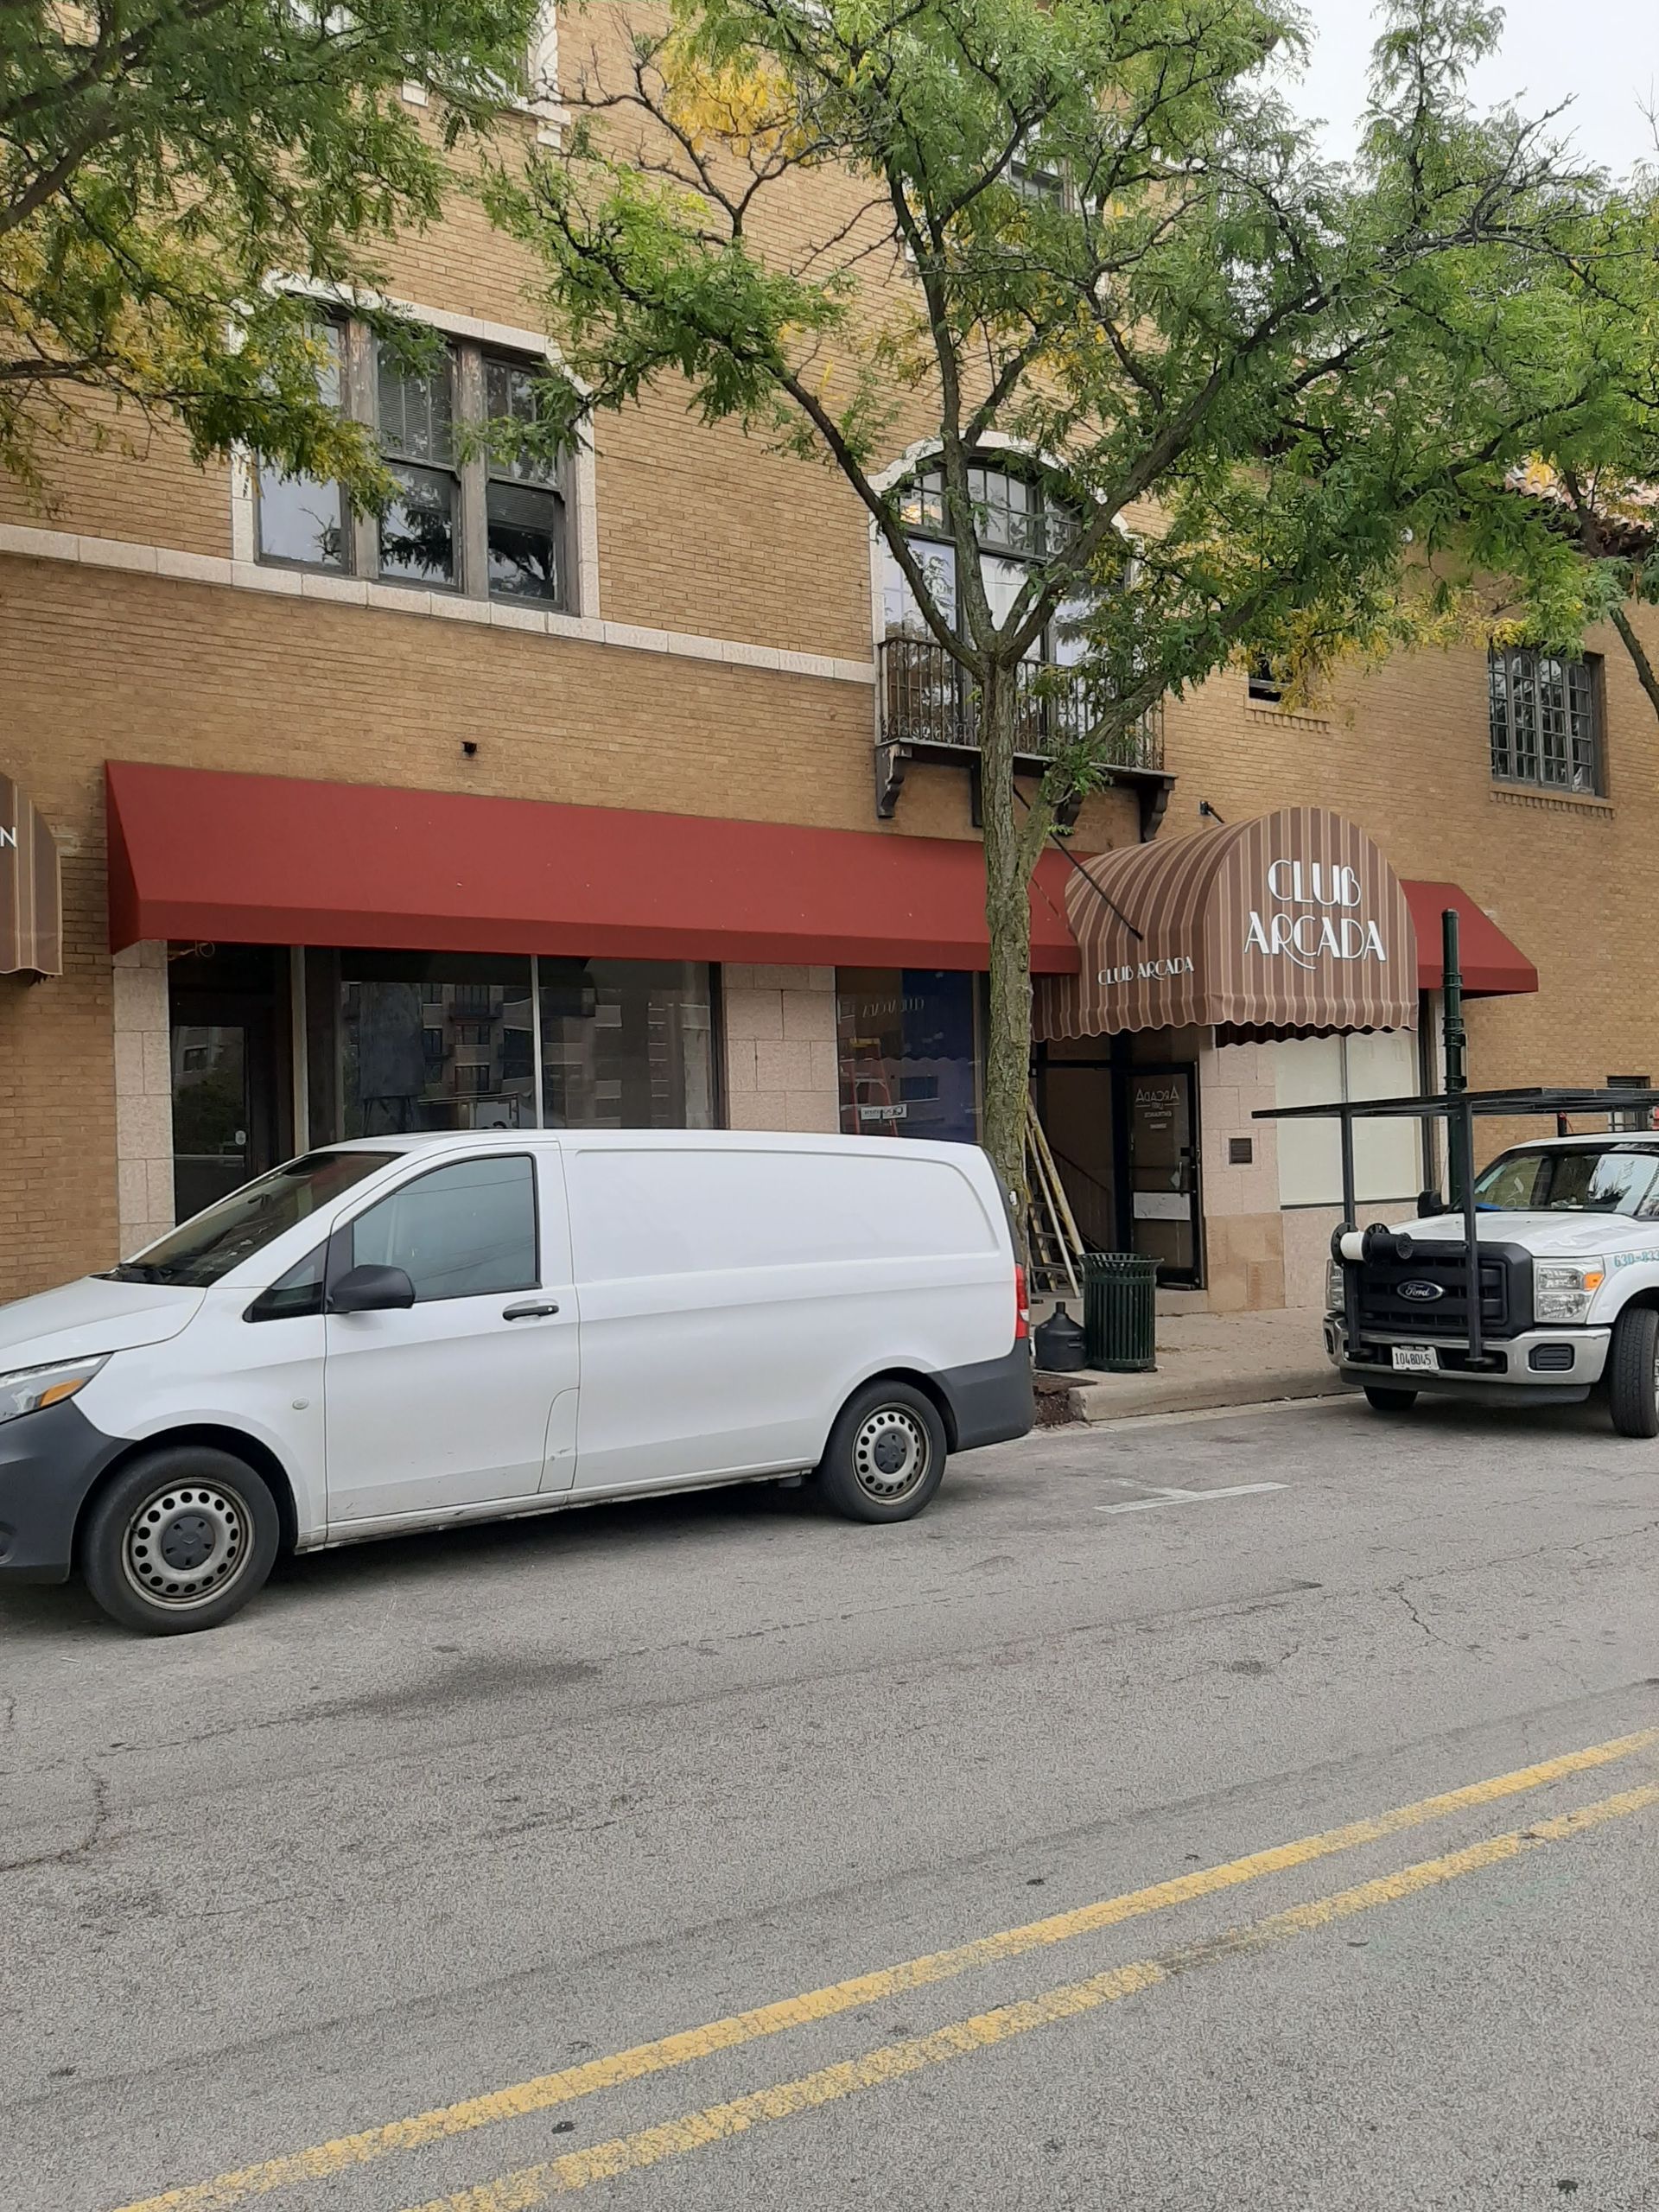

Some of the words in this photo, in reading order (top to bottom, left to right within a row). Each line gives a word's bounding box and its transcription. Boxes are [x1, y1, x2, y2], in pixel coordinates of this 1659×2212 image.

[0, 826, 17, 848] N
[1268, 859, 1361, 906] CLUB
[1244, 911, 1386, 969] ARCADA
[1097, 964, 1134, 985] CLUB
[1137, 956, 1194, 981] ARCADA
[1405, 1283, 1431, 1297] Ford
[1395, 1352, 1432, 1366] 1048045
